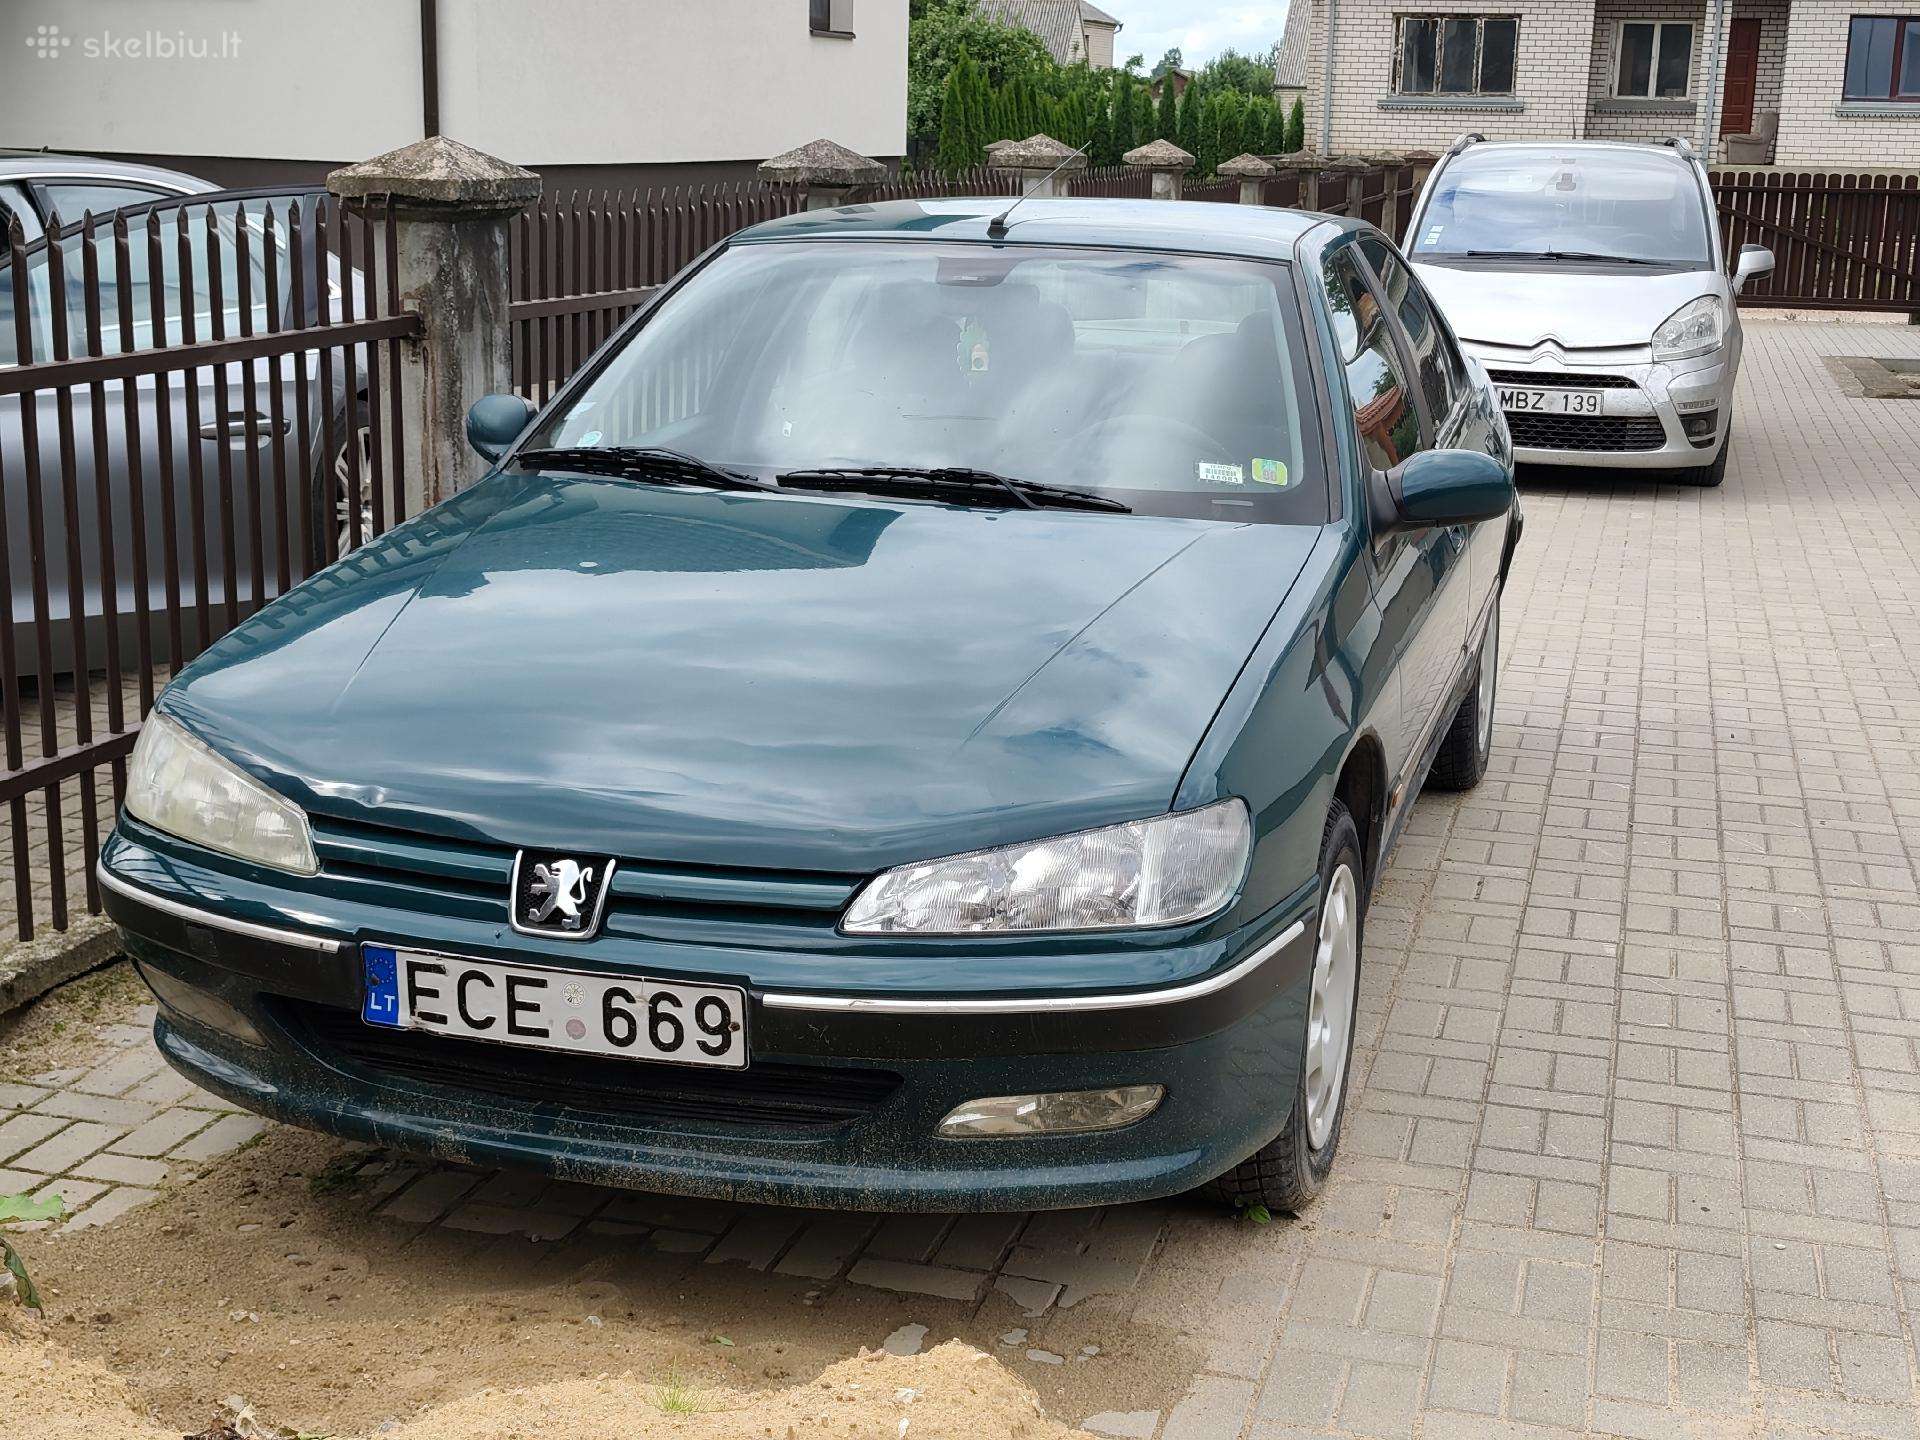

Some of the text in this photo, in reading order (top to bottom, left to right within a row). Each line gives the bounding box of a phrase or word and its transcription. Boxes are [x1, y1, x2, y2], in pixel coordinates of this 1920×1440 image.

[1500, 390, 1598, 413] MBZ 139
[370, 992, 396, 1012] LT
[405, 959, 733, 1057] ECE 669
